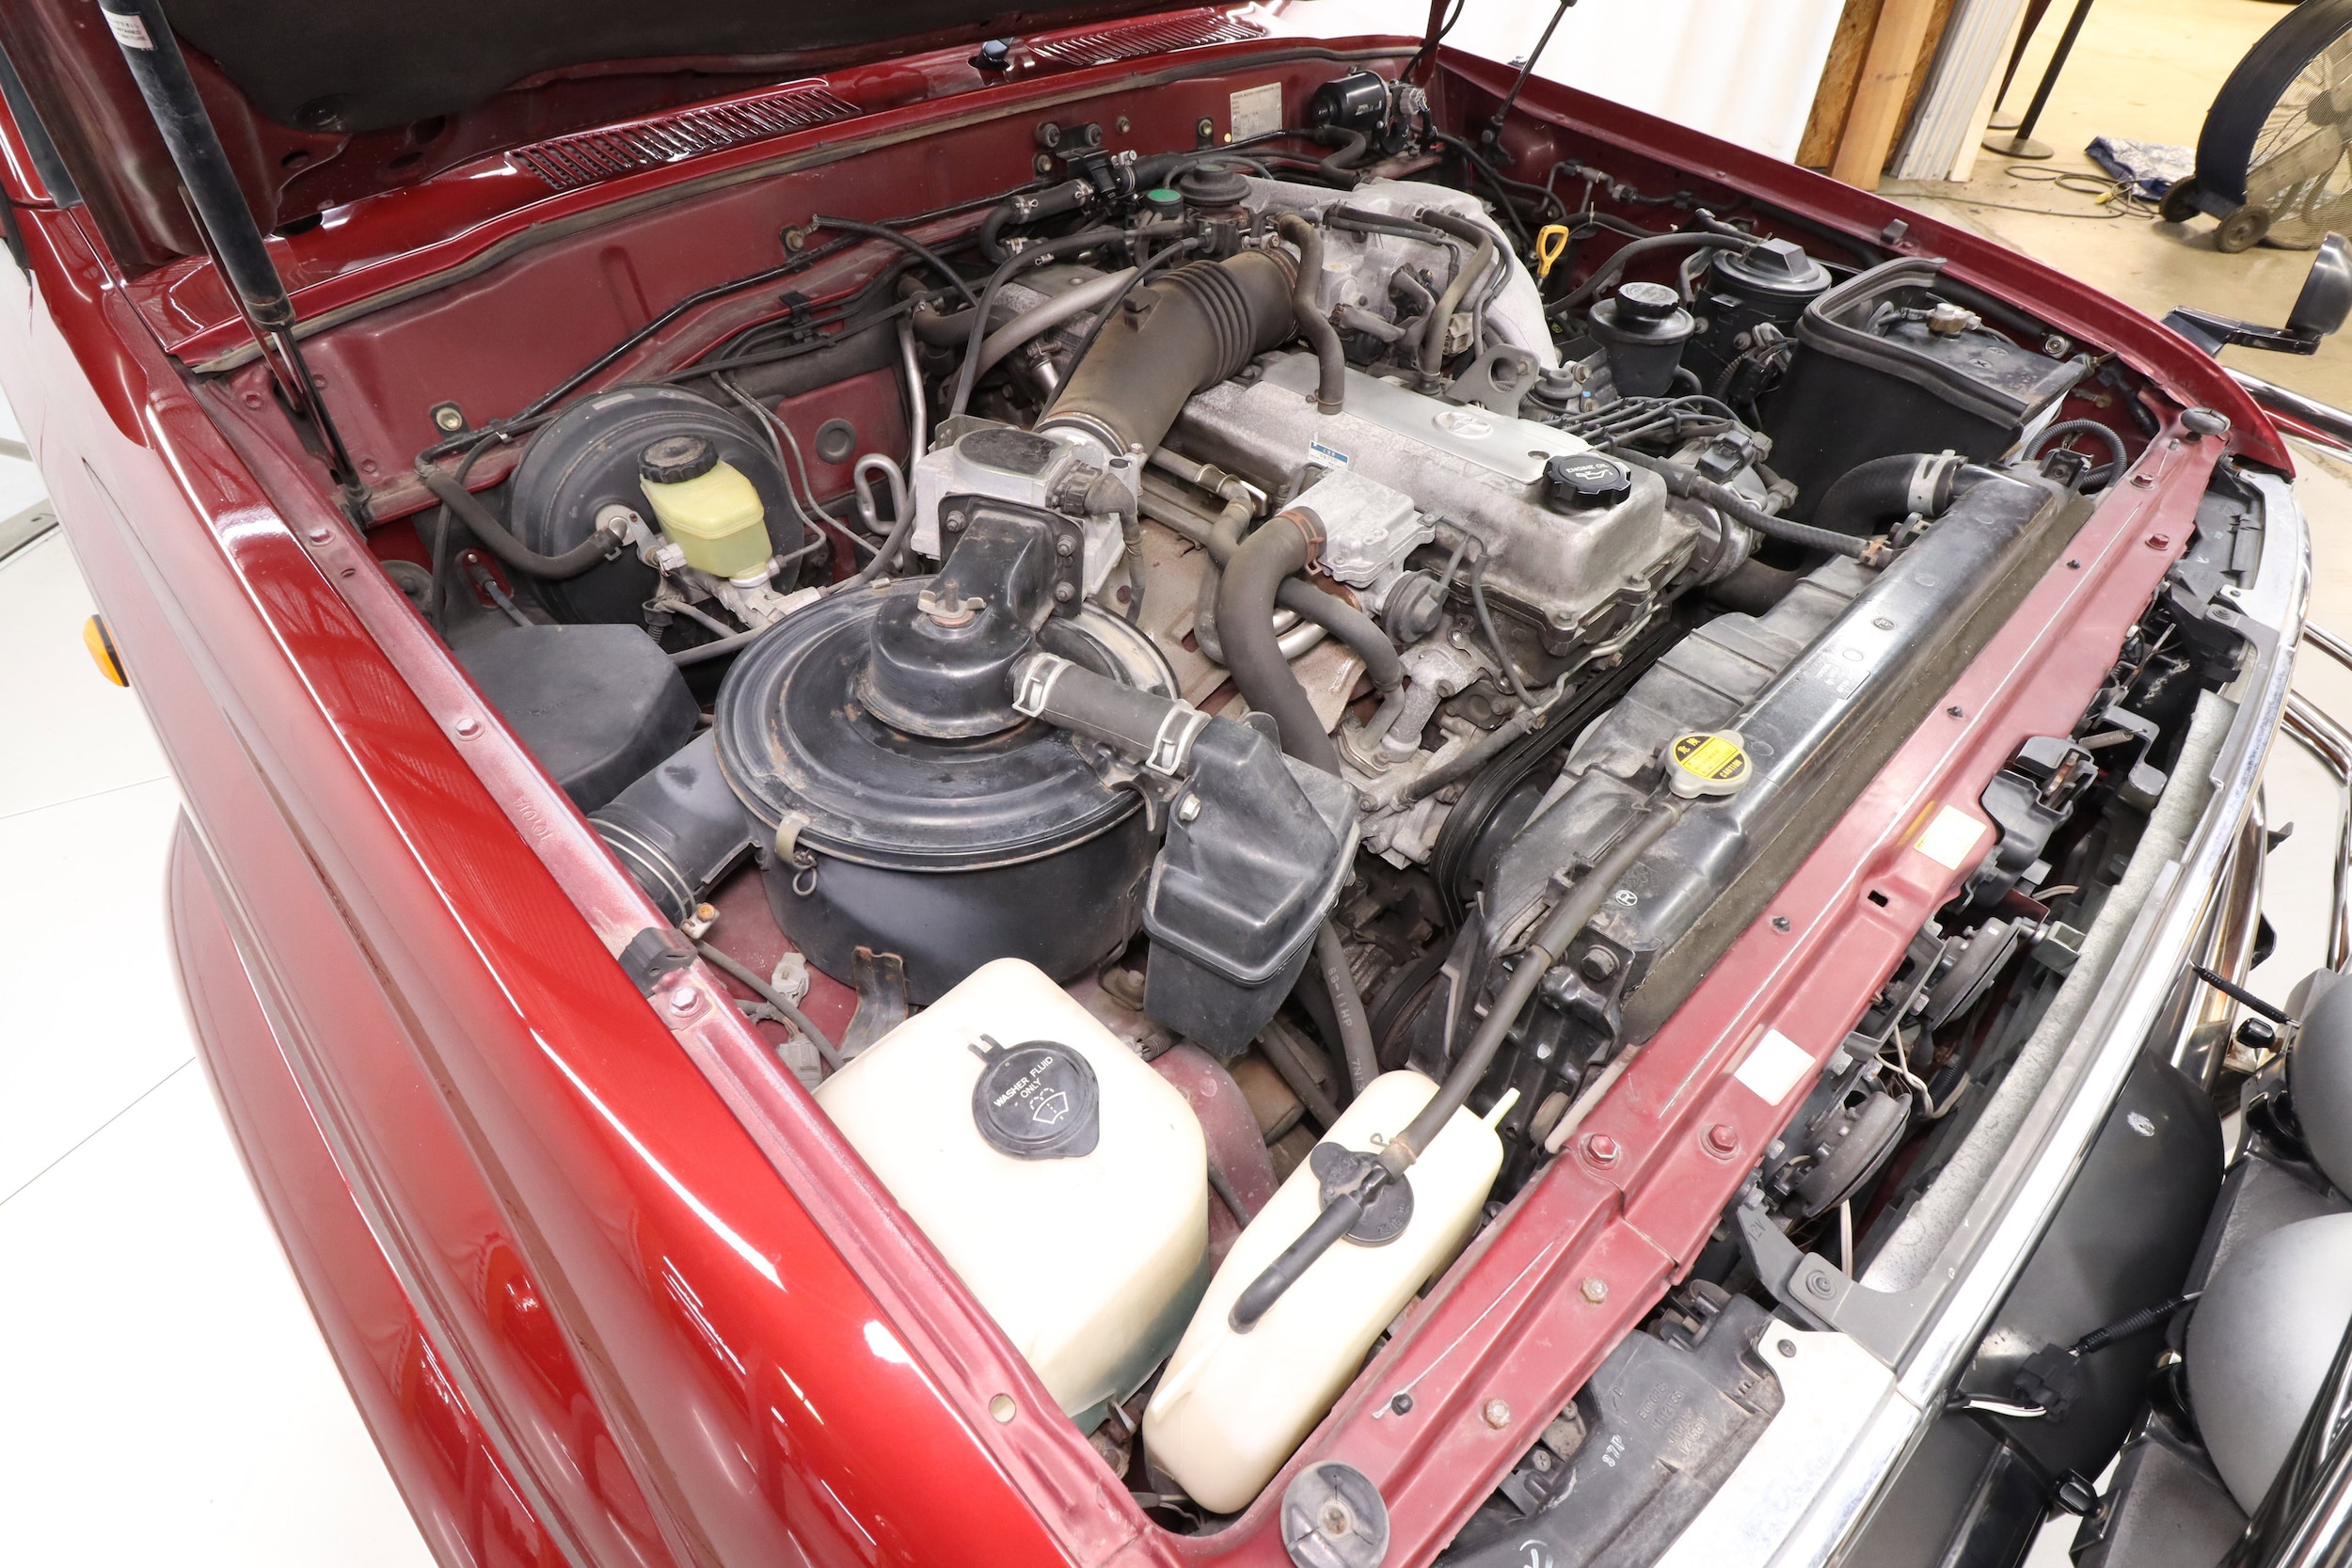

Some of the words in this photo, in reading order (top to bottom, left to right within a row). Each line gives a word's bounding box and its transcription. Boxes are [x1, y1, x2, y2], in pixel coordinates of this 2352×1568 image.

[1565, 464, 1596, 473] ENGINE
[1719, 758, 1743, 779] CAUTION
[993, 1077, 1029, 1107] WASHER
[1029, 1055, 1054, 1078] FLUID
[1020, 1078, 1041, 1099] ONLY
